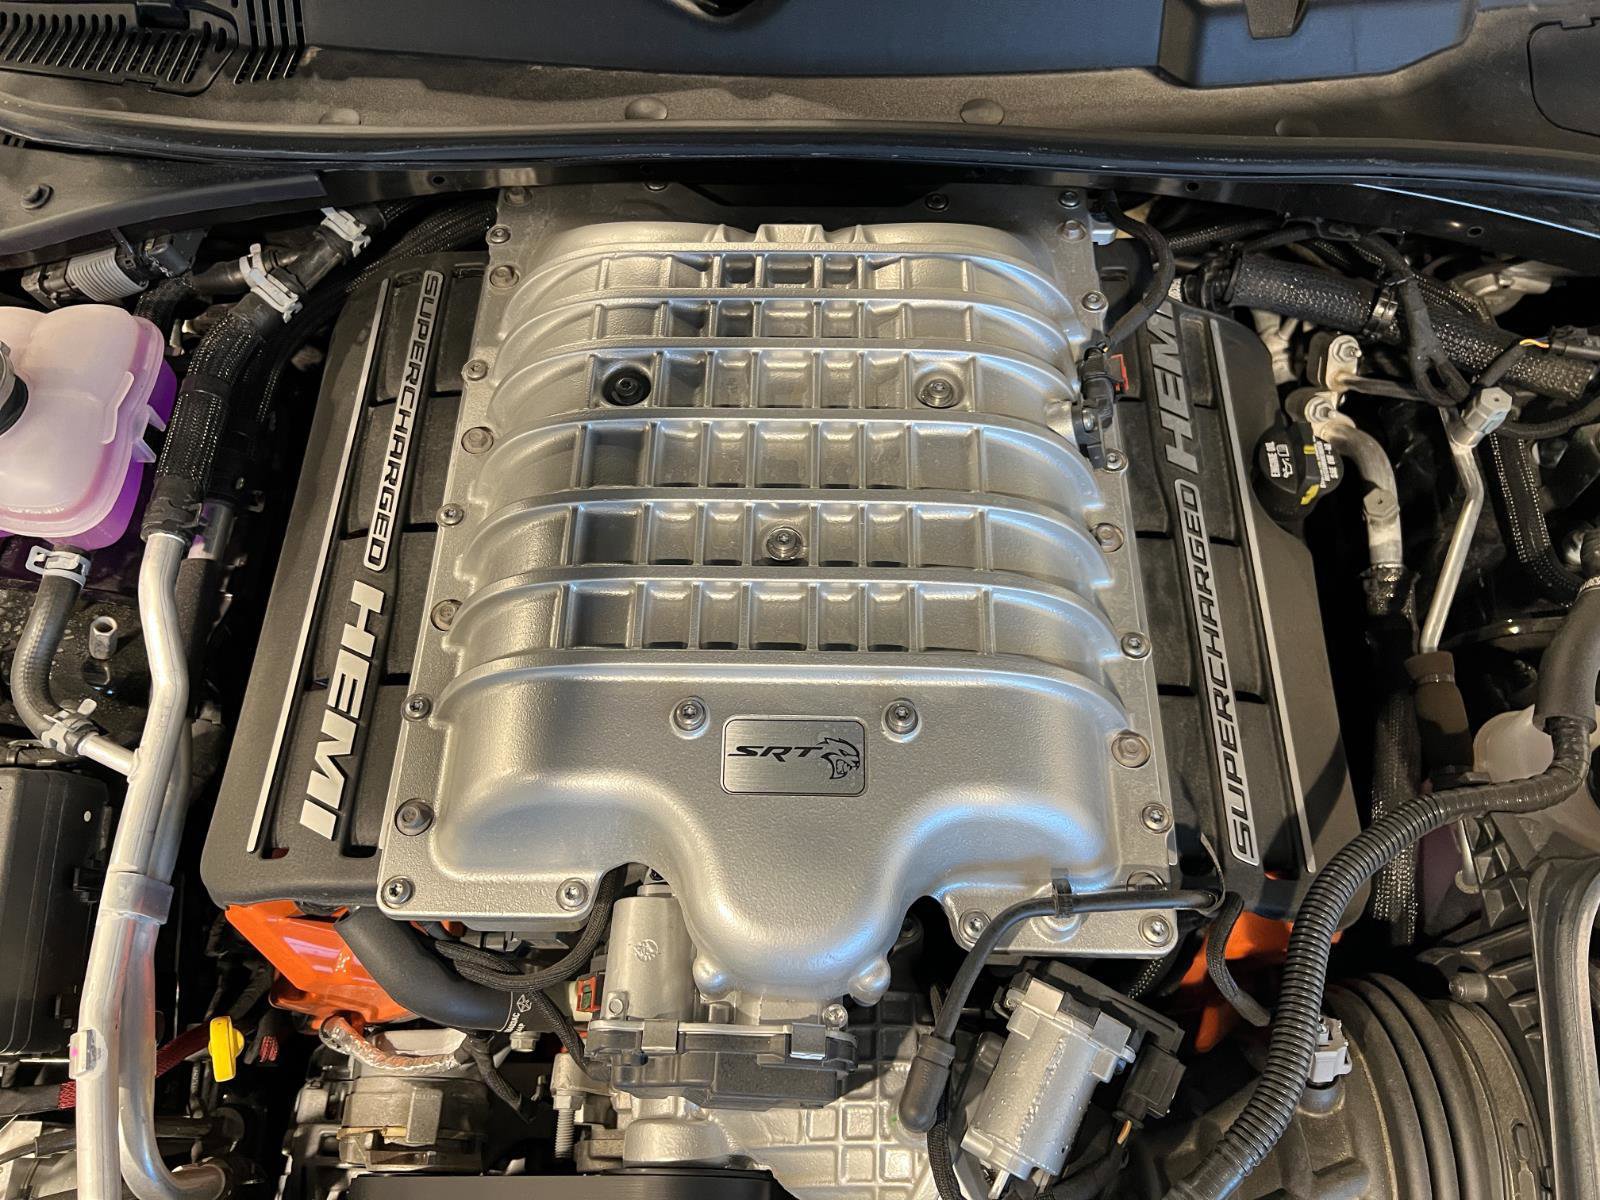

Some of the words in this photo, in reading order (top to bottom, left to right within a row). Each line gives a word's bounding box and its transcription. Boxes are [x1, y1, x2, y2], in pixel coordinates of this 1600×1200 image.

[368, 275, 439, 567] SUPERCHARGED
[300, 580, 384, 840] HEMI
[728, 746, 822, 762] SRT
[1180, 484, 1256, 860] SUPERCHARGED
